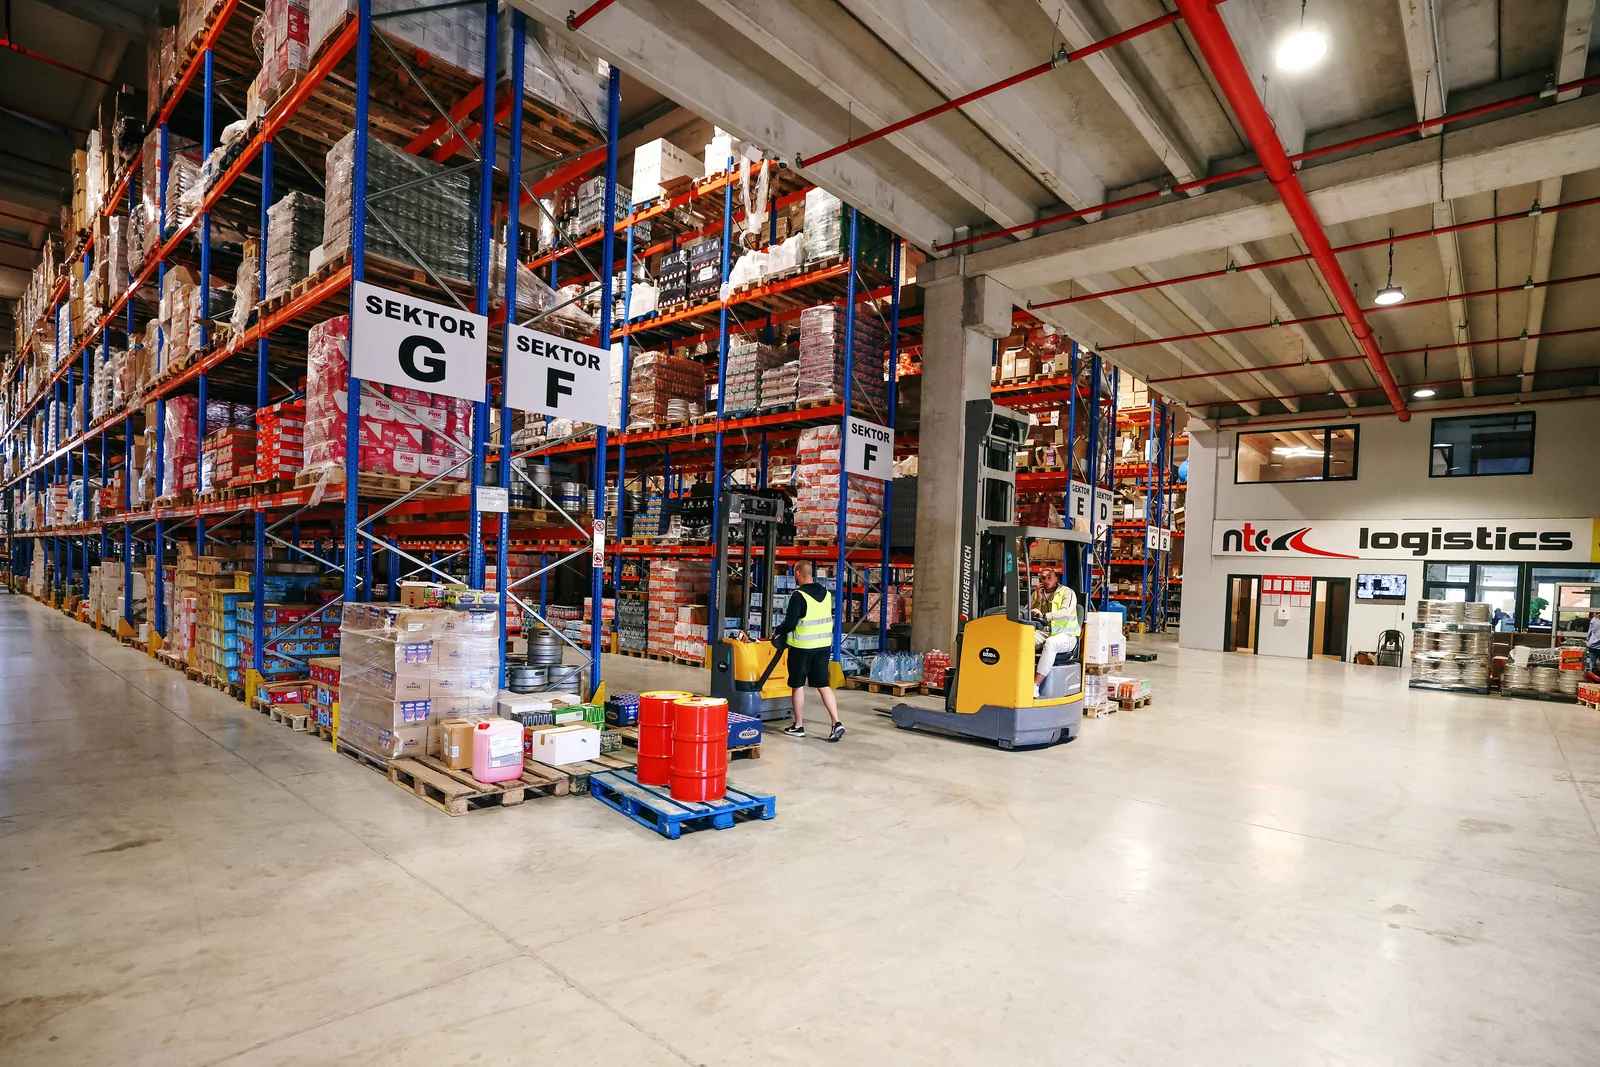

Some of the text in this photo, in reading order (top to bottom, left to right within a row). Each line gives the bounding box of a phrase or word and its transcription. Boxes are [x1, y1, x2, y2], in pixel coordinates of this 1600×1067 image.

[365, 295, 476, 339] SEKTOR
[398, 334, 447, 383] G
[516, 335, 601, 371] SEKTOR
[546, 367, 576, 409] F
[851, 423, 890, 443] SEKTOR
[863, 443, 878, 471] F
[1072, 484, 1090, 496] SEKTOR
[1096, 491, 1112, 502] SEKTOR
[1077, 497, 1084, 516] E
[1100, 503, 1107, 521] D
[1222, 523, 1573, 556] ntc logistics
[960, 545, 972, 621] JUNGHEINRICH
